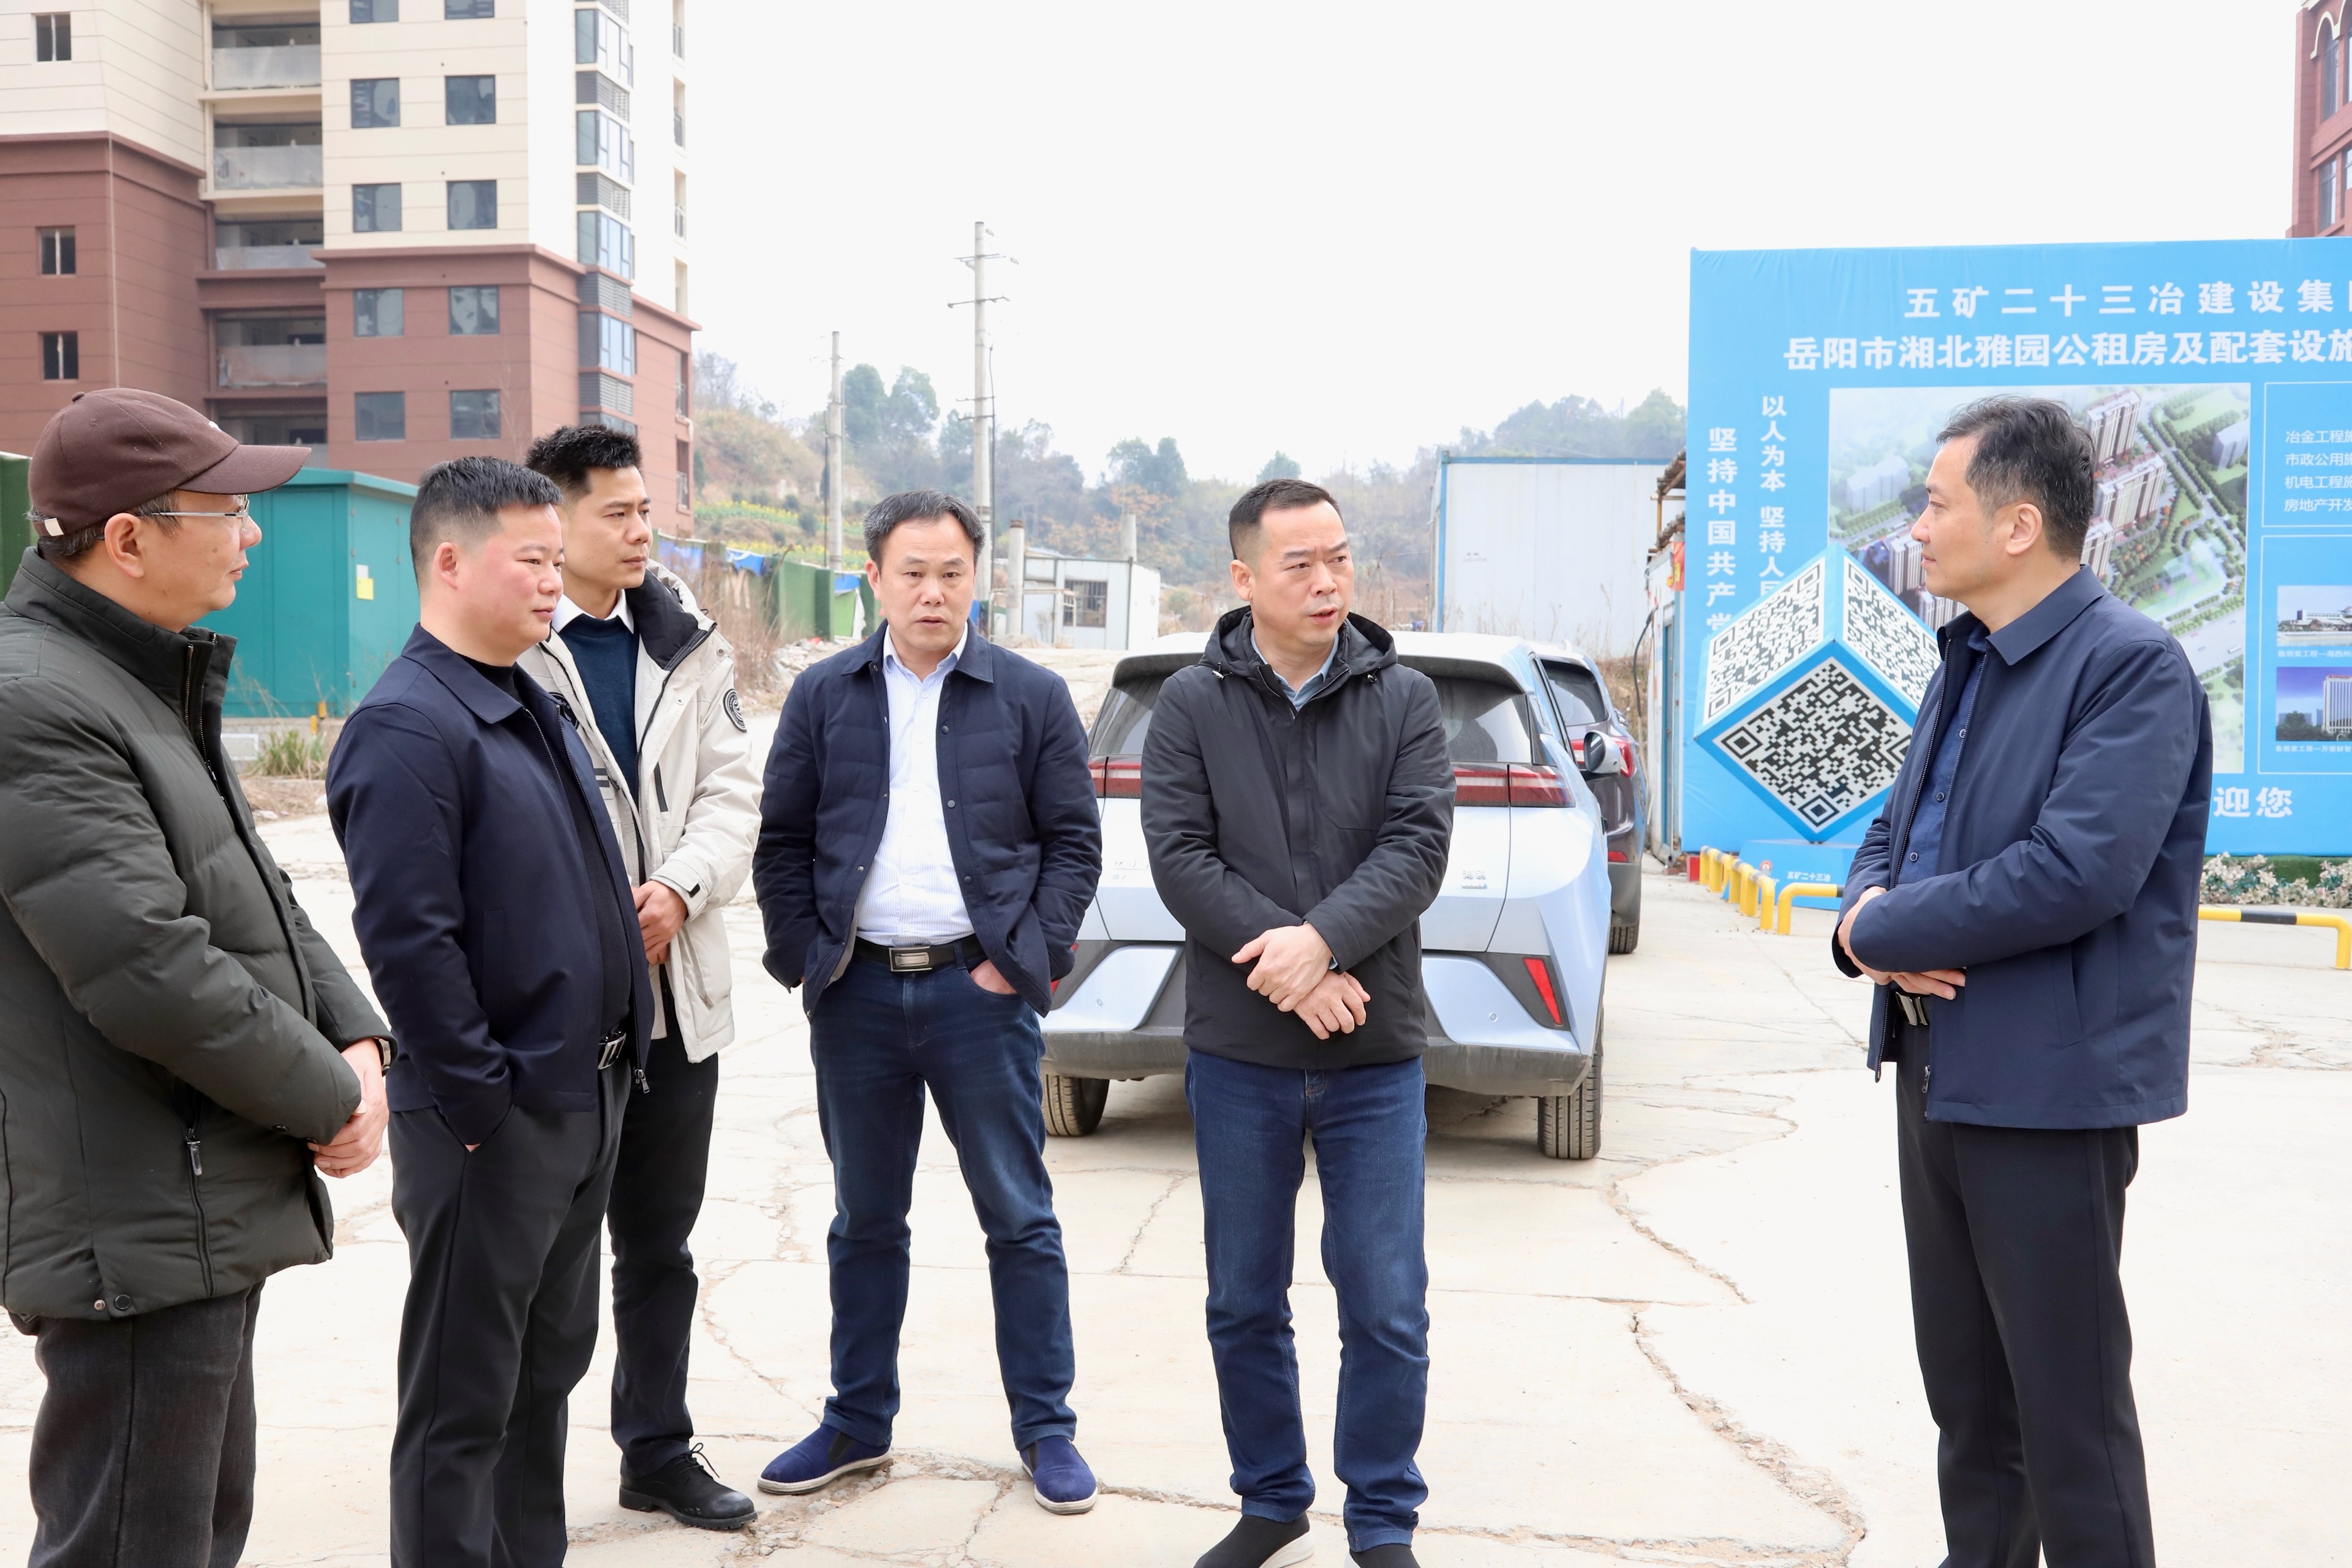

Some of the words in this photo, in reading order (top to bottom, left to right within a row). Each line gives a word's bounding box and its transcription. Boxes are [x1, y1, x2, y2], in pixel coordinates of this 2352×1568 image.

[1904, 279, 2352, 318] 五矿二十三冶建设集
[1783, 328, 2352, 371] 岳阳市湘北雅园公租房及配套设施
[1760, 395, 1787, 492] 以人为本
[2212, 786, 2293, 818] 迎您
[1786, 870, 1831, 883] 五矿二十三冶
